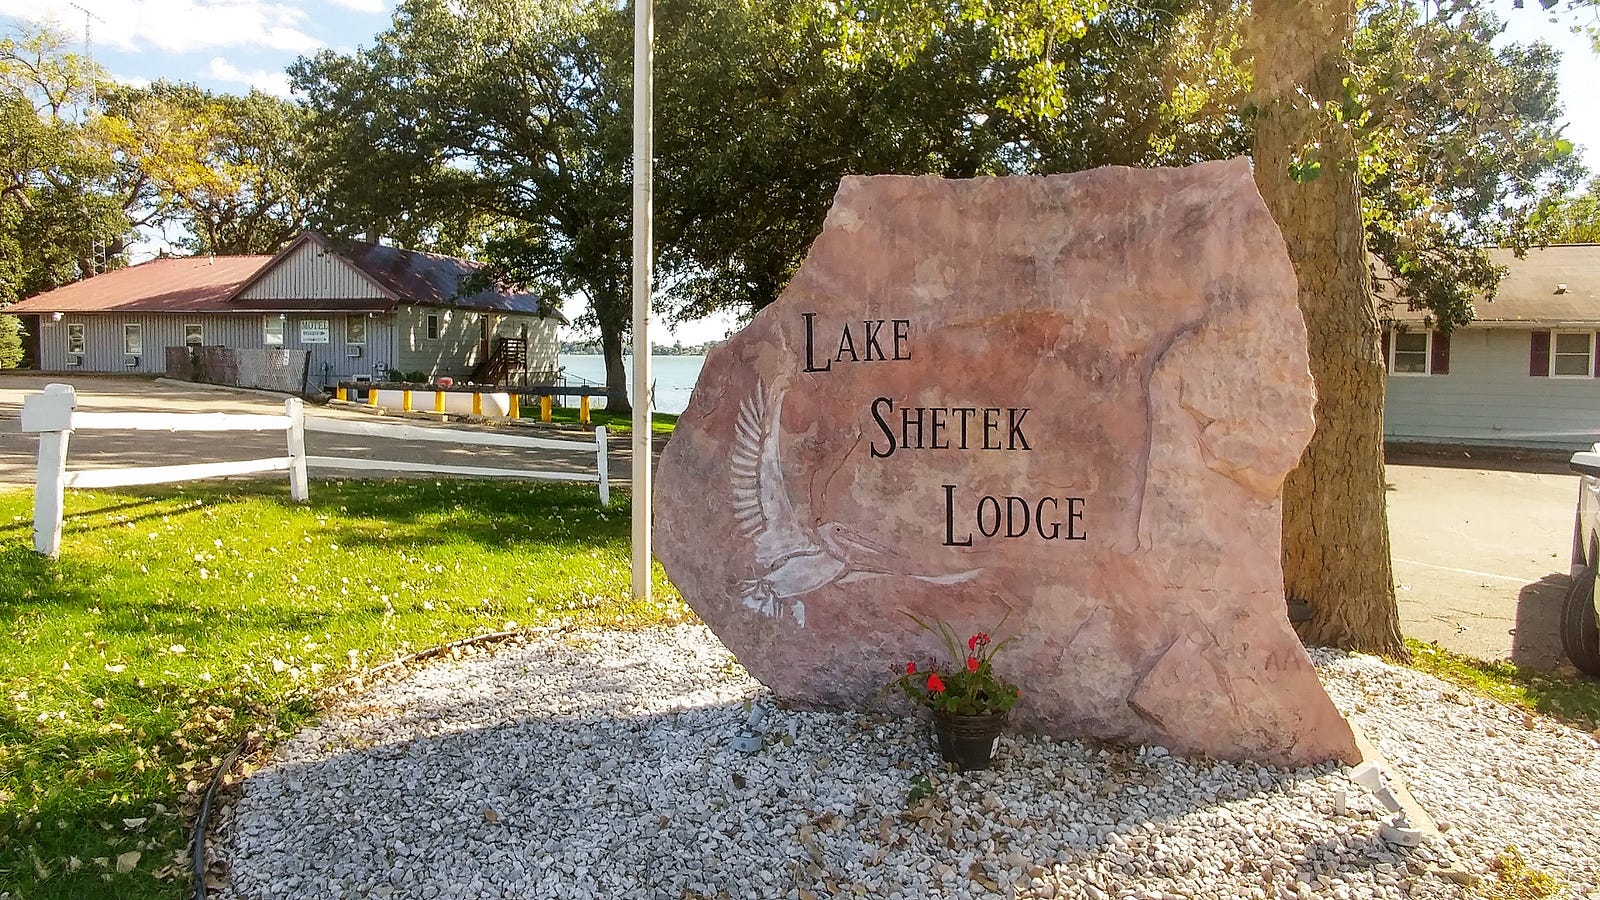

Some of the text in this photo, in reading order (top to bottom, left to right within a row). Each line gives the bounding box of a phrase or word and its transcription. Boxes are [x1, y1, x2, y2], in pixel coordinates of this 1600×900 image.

[302, 320, 328, 330] MOTEL
[801, 312, 911, 373] LAKE
[870, 397, 1032, 458] SHETEK
[941, 484, 1087, 546] LODGE
